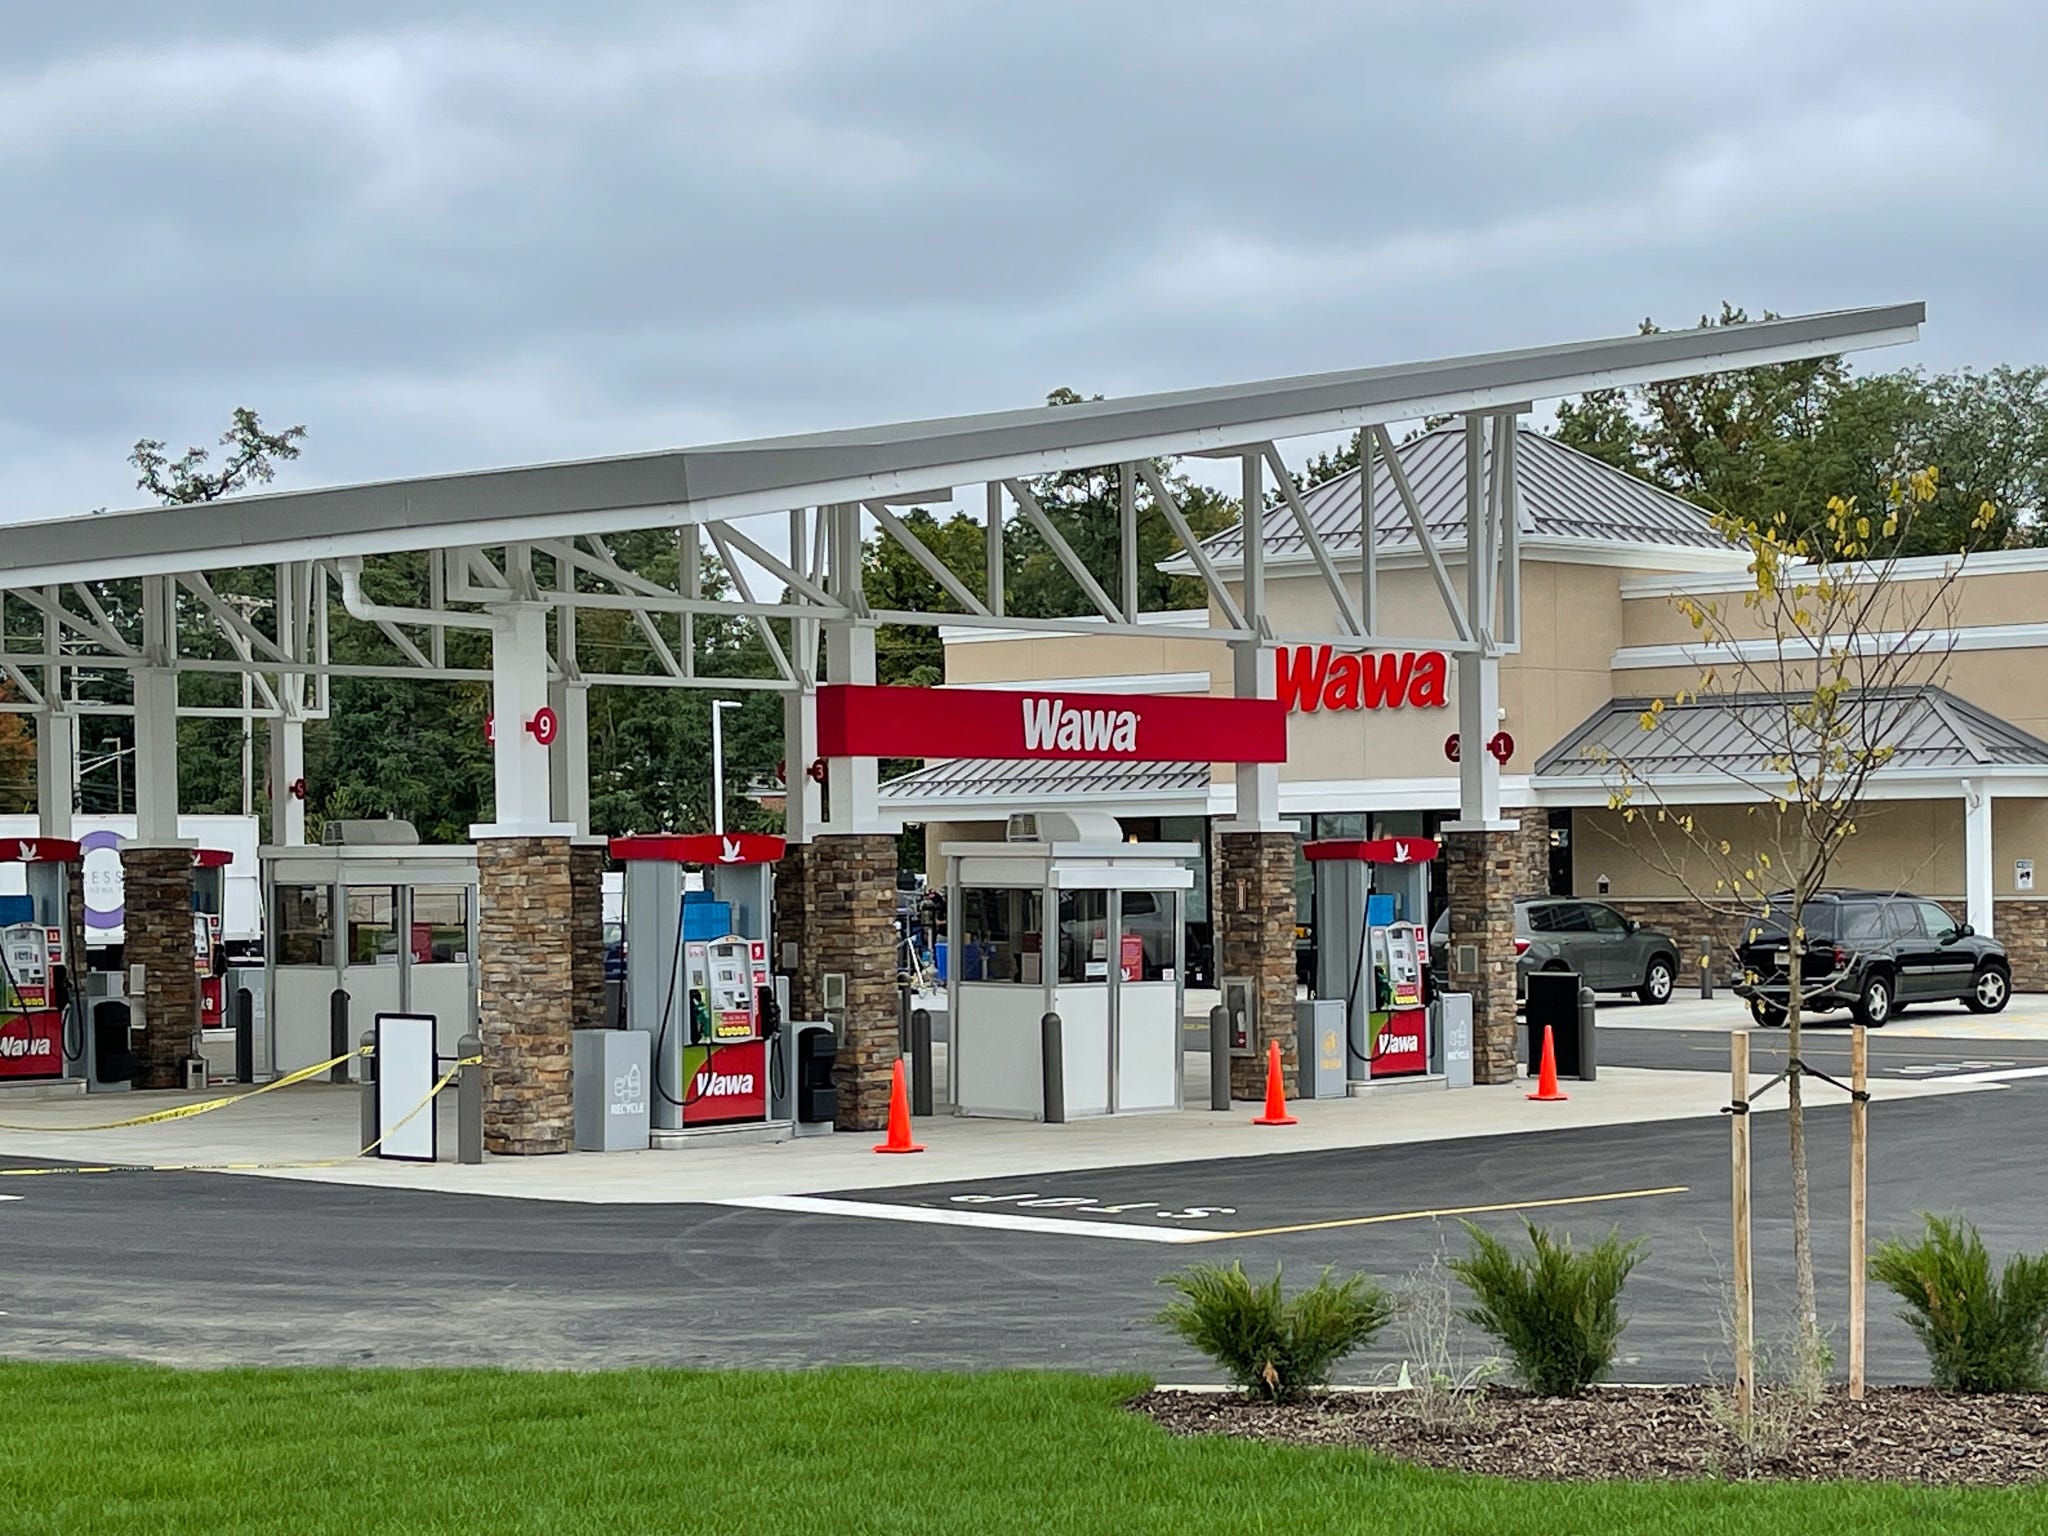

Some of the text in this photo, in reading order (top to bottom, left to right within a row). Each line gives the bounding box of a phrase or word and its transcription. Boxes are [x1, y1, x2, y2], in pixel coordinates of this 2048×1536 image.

[1275, 644, 1448, 713] Wawa
[540, 716, 551, 738] 9
[1023, 698, 1137, 752] Wawa
[1450, 740, 1460, 756] 2
[1498, 739, 1507, 755] 1
[816, 764, 823, 779] 3
[1378, 1033, 1418, 1054] Wawa
[696, 1071, 754, 1097] Wawa
[610, 1102, 645, 1115] RECYCLE
